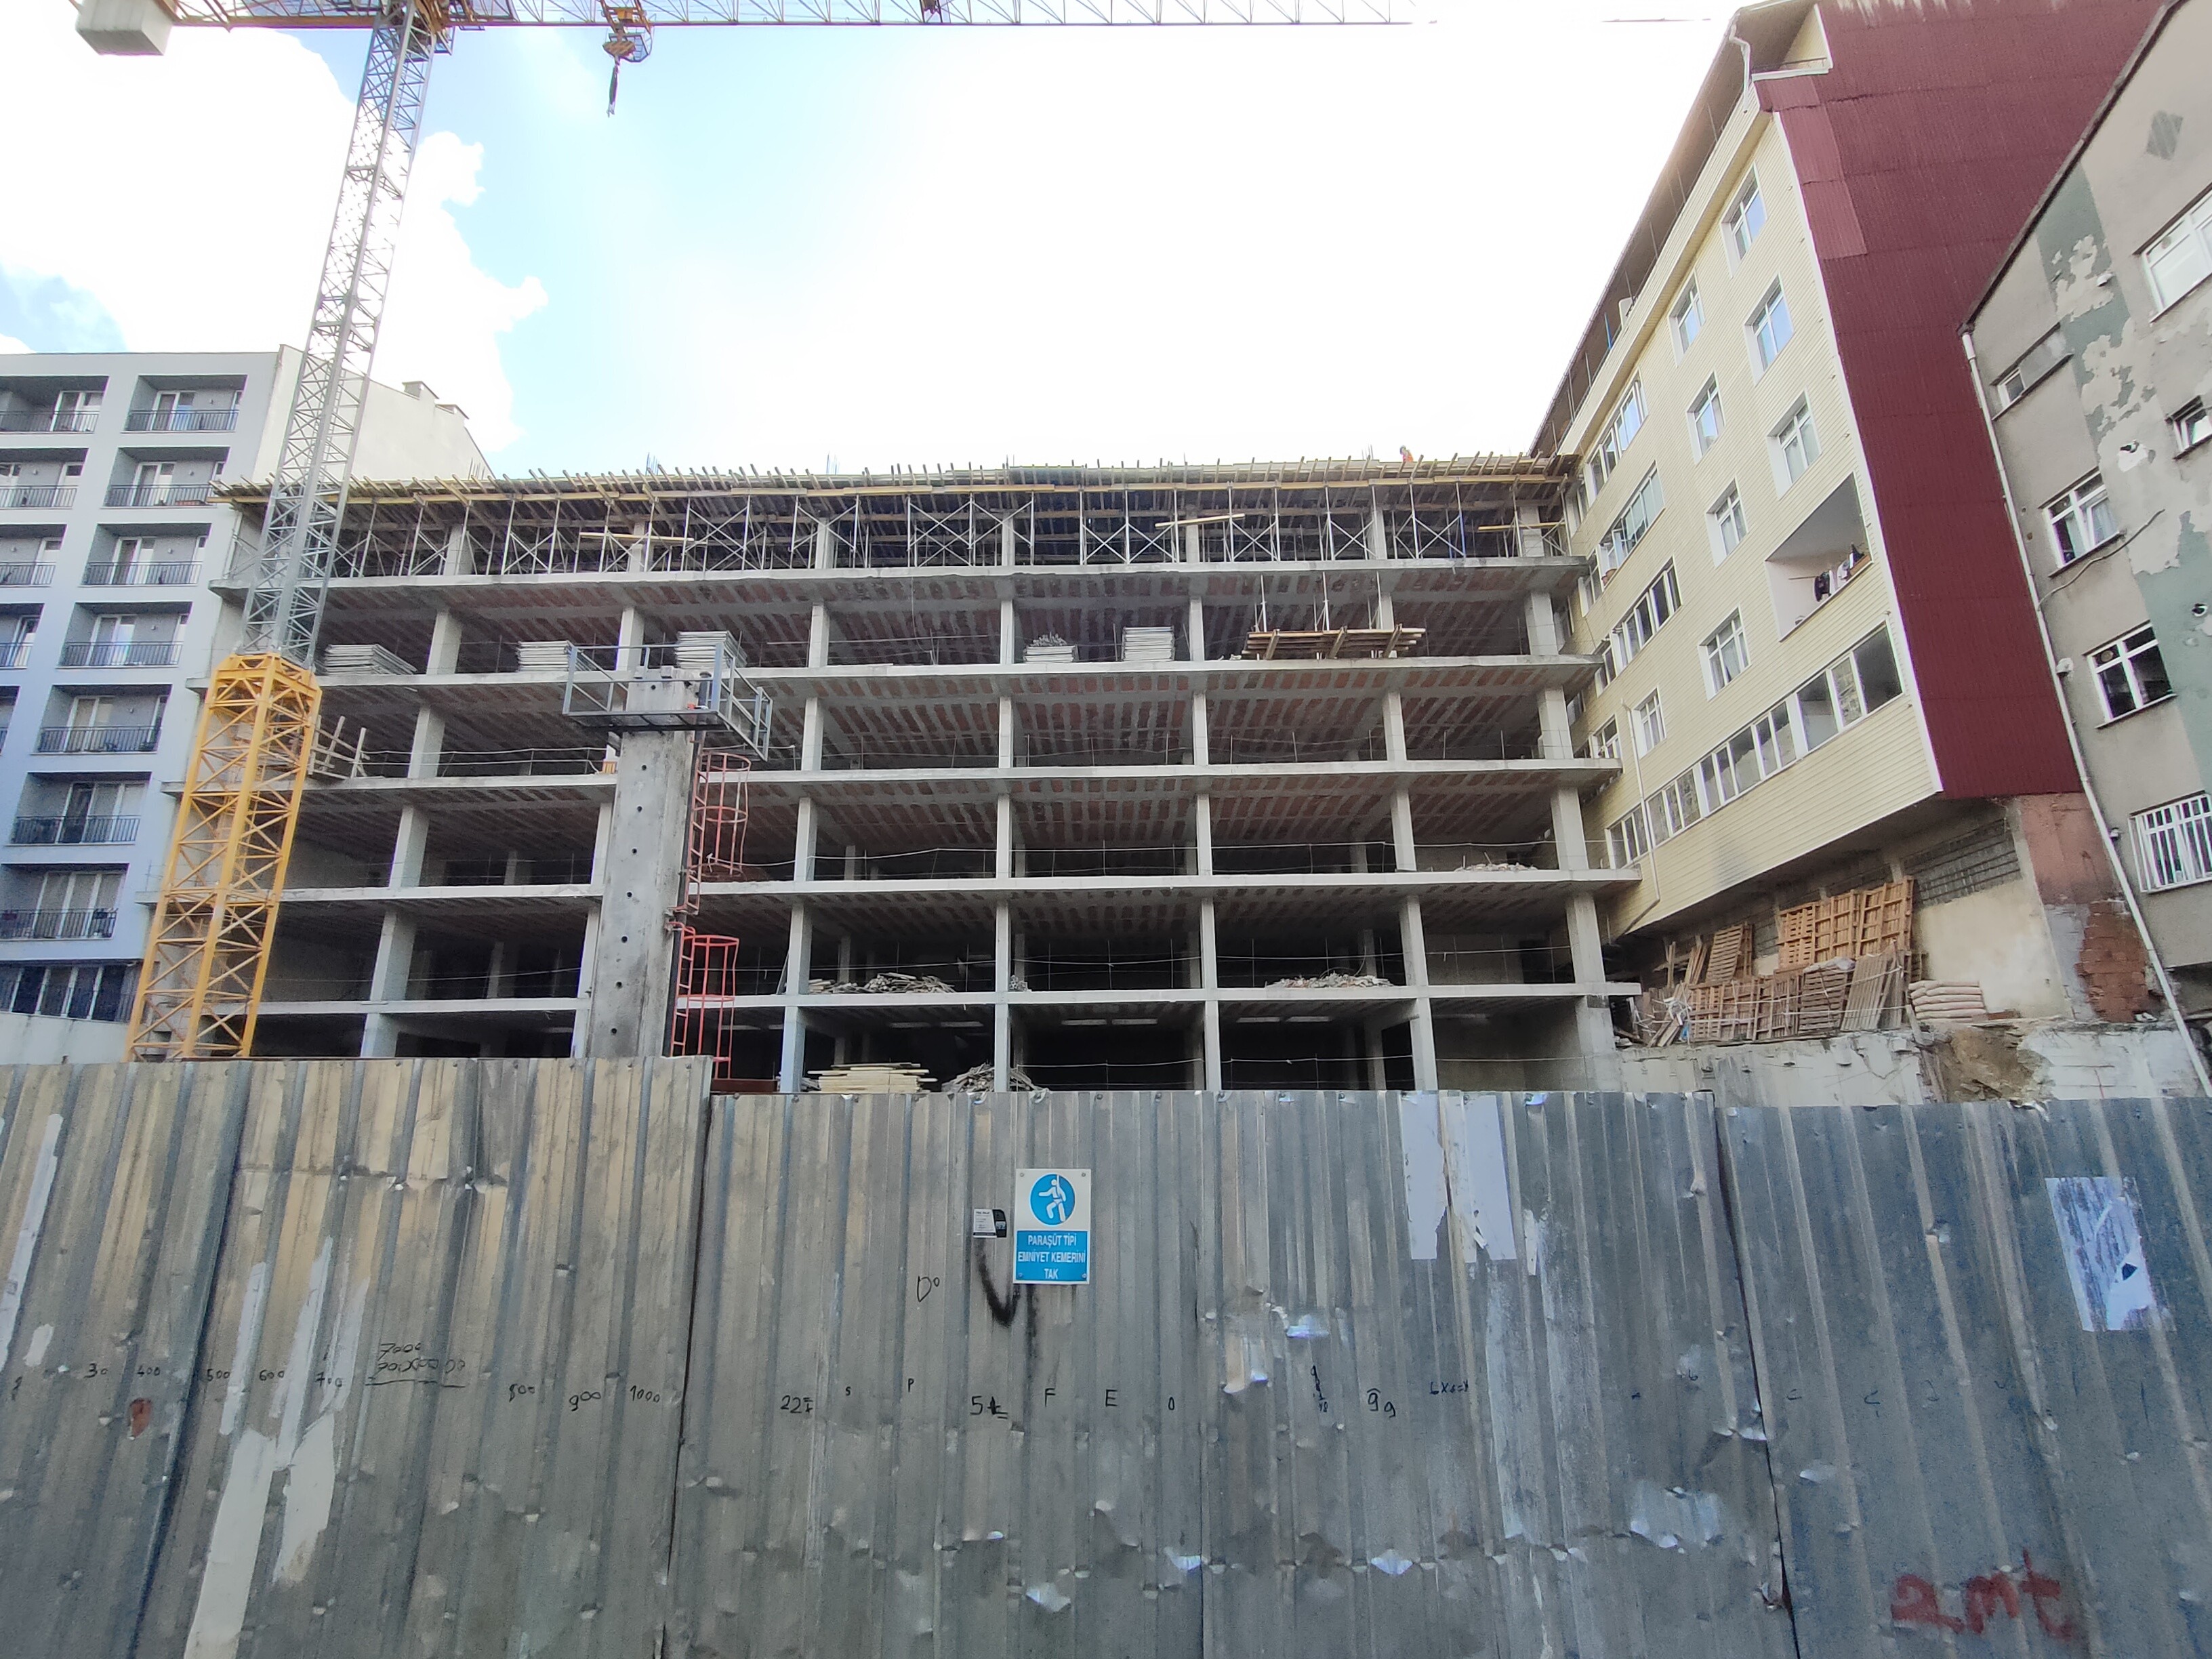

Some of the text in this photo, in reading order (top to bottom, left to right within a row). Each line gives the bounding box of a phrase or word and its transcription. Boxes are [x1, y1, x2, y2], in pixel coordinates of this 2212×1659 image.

[1027, 1233, 1077, 1248] PARAŞÜT TİPİ
[1018, 1249, 1086, 1263] EMNİYET KEMERİNİ
[1044, 1268, 1059, 1279] TAK
